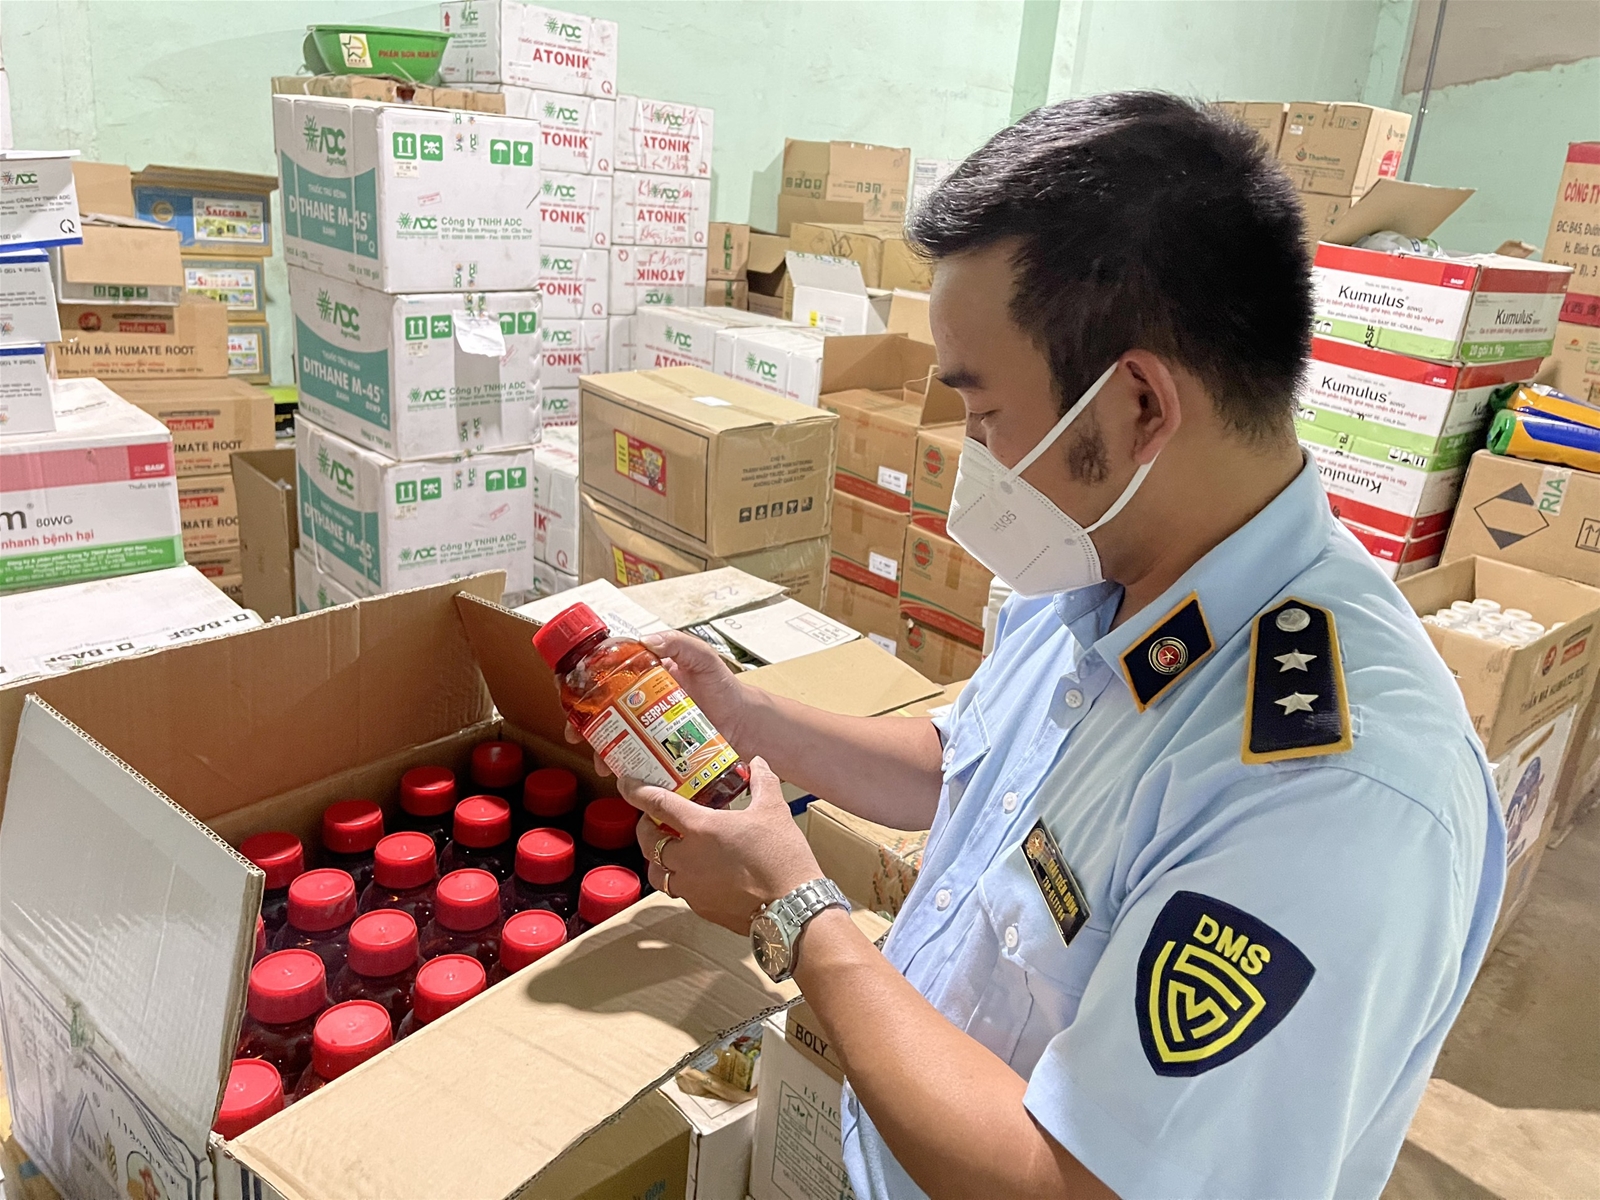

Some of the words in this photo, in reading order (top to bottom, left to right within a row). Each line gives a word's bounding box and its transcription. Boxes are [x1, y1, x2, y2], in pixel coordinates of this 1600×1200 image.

[559, 23, 582, 38] ADC
[532, 48, 592, 71] ATONIK
[556, 108, 578, 121] ADC
[320, 126, 346, 156] ADC
[542, 132, 589, 150] TONIK
[15, 173, 37, 185] ADC
[554, 185, 576, 198] ADC
[289, 195, 335, 224] DTHANE
[338, 206, 367, 231] M-45
[540, 209, 586, 225] TONIK
[637, 209, 686, 224] ATONIK
[413, 217, 437, 229] ADC
[441, 217, 465, 226] Công
[467, 218, 475, 227] ty
[478, 218, 501, 226] TNHH
[504, 218, 522, 226] ADC
[551, 259, 573, 271] ADC
[637, 269, 685, 281] ATONIK
[539, 283, 583, 296] TONIK
[1338, 285, 1405, 309] Kumulus
[333, 302, 360, 332] ADC
[1494, 309, 1533, 325] Kumulus
[551, 331, 572, 342] ADC
[674, 332, 692, 348] ADC
[1364, 325, 1375, 348] ASF
[116, 346, 162, 355] HUMATE
[166, 346, 194, 355] ROOT
[543, 354, 582, 366] ONIK
[757, 360, 777, 378] ADC
[303, 356, 349, 390] DITHANE
[352, 377, 380, 403] M-45
[423, 390, 445, 402] ADC
[450, 387, 471, 396] Công
[474, 386, 481, 394] ty
[484, 384, 506, 392] TNHH
[1321, 376, 1387, 403] Kumulus
[548, 399, 568, 410] ADC
[213, 440, 241, 450] ROOT
[331, 459, 354, 491] ADC
[1318, 466, 1382, 493] Kumulus
[36, 515, 73, 528] 80WG
[217, 517, 240, 526] ROO
[1, 536, 39, 549] nhanh
[43, 532, 73, 546] bệnh
[77, 529, 94, 542] hại
[440, 544, 462, 552] Công
[465, 541, 472, 549] ty
[474, 536, 497, 546] TNHH
[500, 533, 516, 541] ADC
[414, 547, 436, 560] ADC
[640, 698, 671, 726] SERPAL
[1193, 914, 1270, 975] DMS
